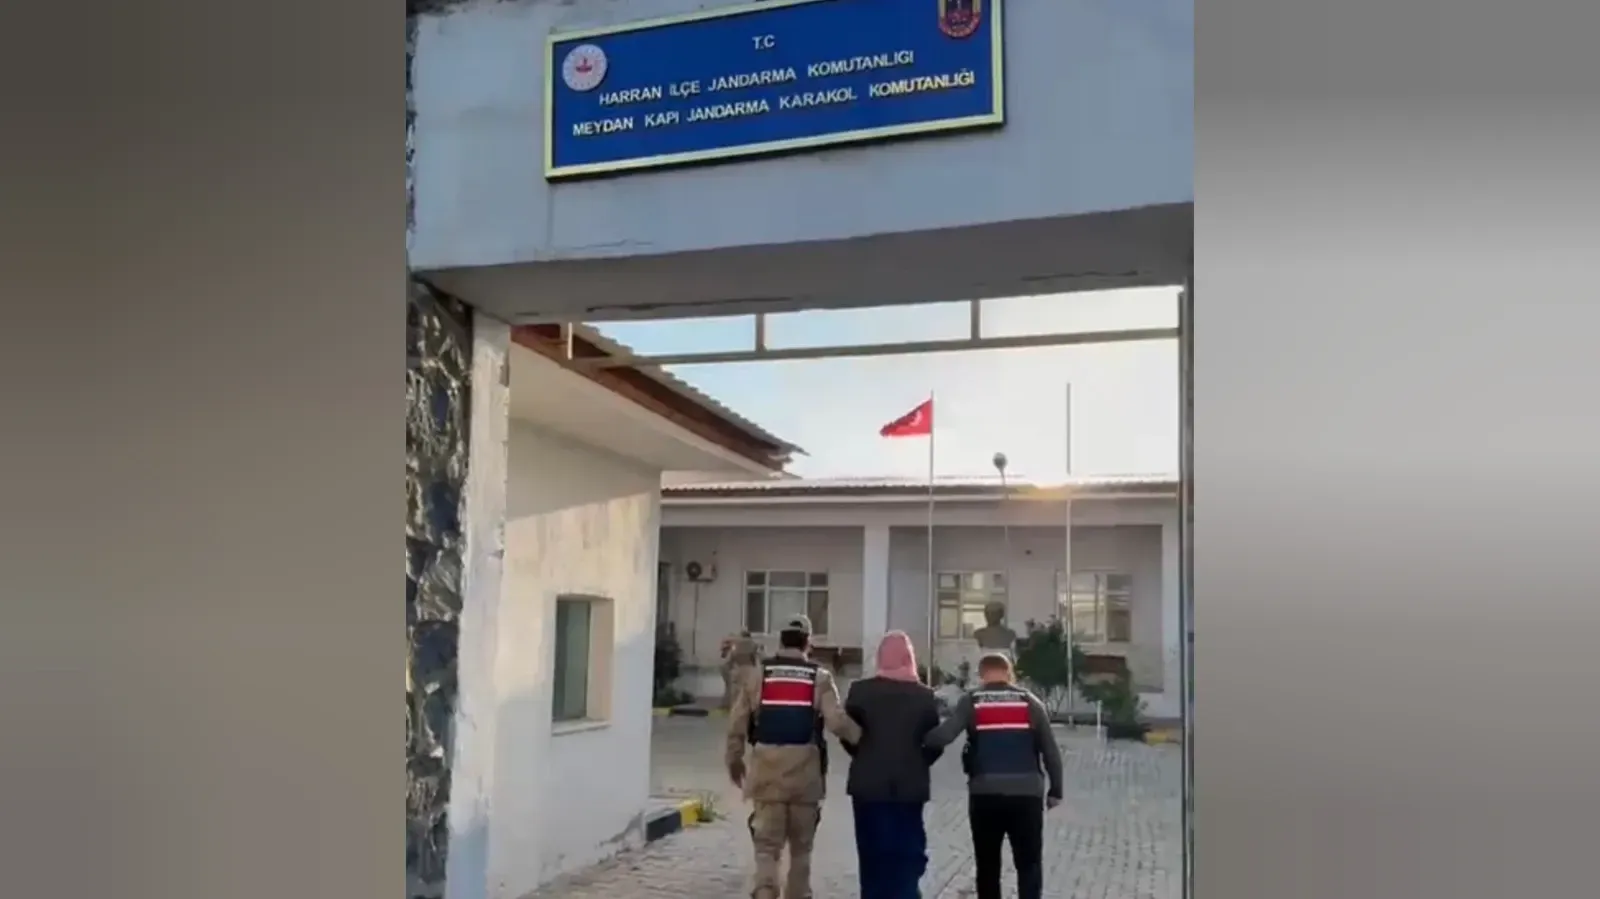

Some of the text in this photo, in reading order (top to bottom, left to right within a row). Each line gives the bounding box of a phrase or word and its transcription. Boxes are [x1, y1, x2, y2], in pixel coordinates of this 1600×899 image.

[572, 69, 975, 136] MEYDAN KAPI JANDARMA KARAKOL KOMUTANLIĞI
[599, 85, 662, 105] HARRAN
[708, 67, 797, 92] JANDARMA
